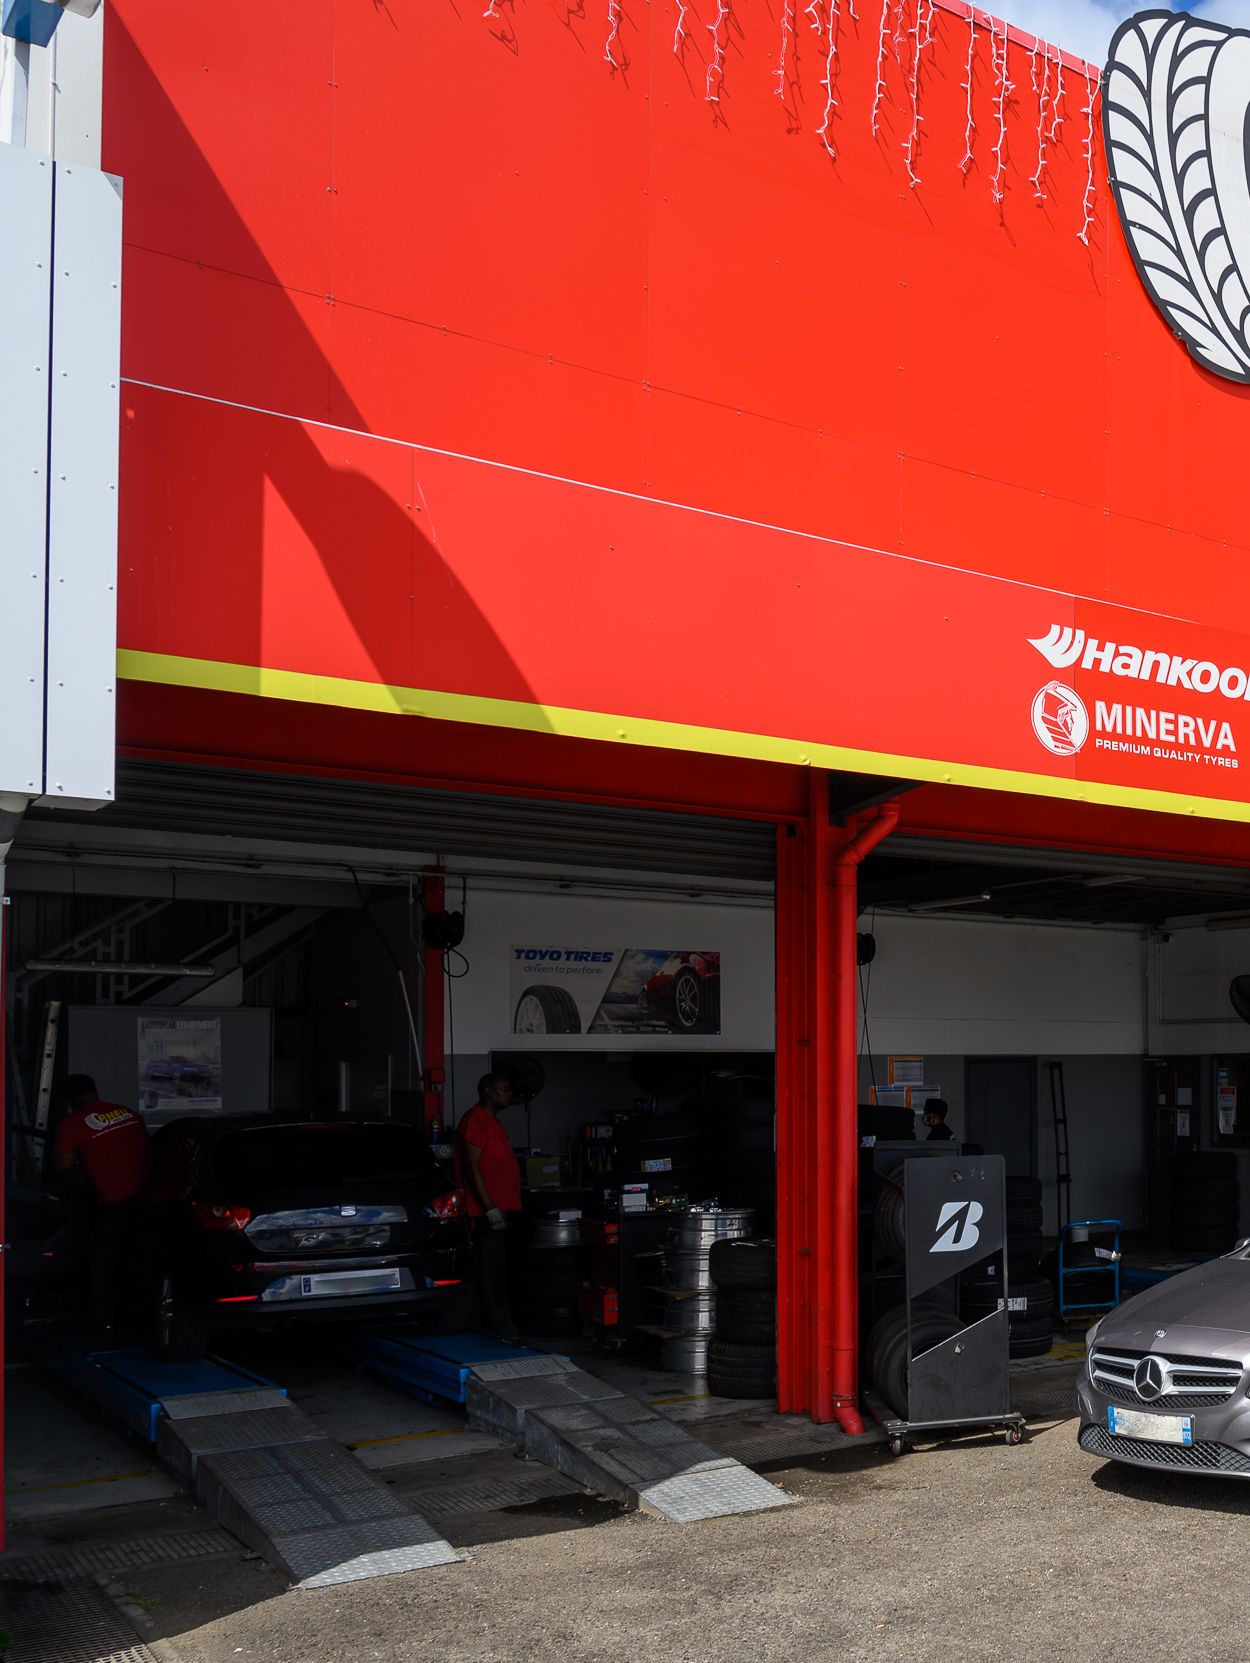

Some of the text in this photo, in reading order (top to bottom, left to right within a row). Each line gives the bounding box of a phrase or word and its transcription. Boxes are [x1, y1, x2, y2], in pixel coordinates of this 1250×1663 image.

[1095, 699, 1237, 753] MINERVA
[1095, 737, 1239, 769] PREMIUM QUALITY TYRES
[514, 949, 614, 963] TOYO TIRES
[524, 963, 604, 976] driven to perform
[176, 1020, 218, 1030] EQUIPMENT
[97, 1108, 129, 1123] PNEU
